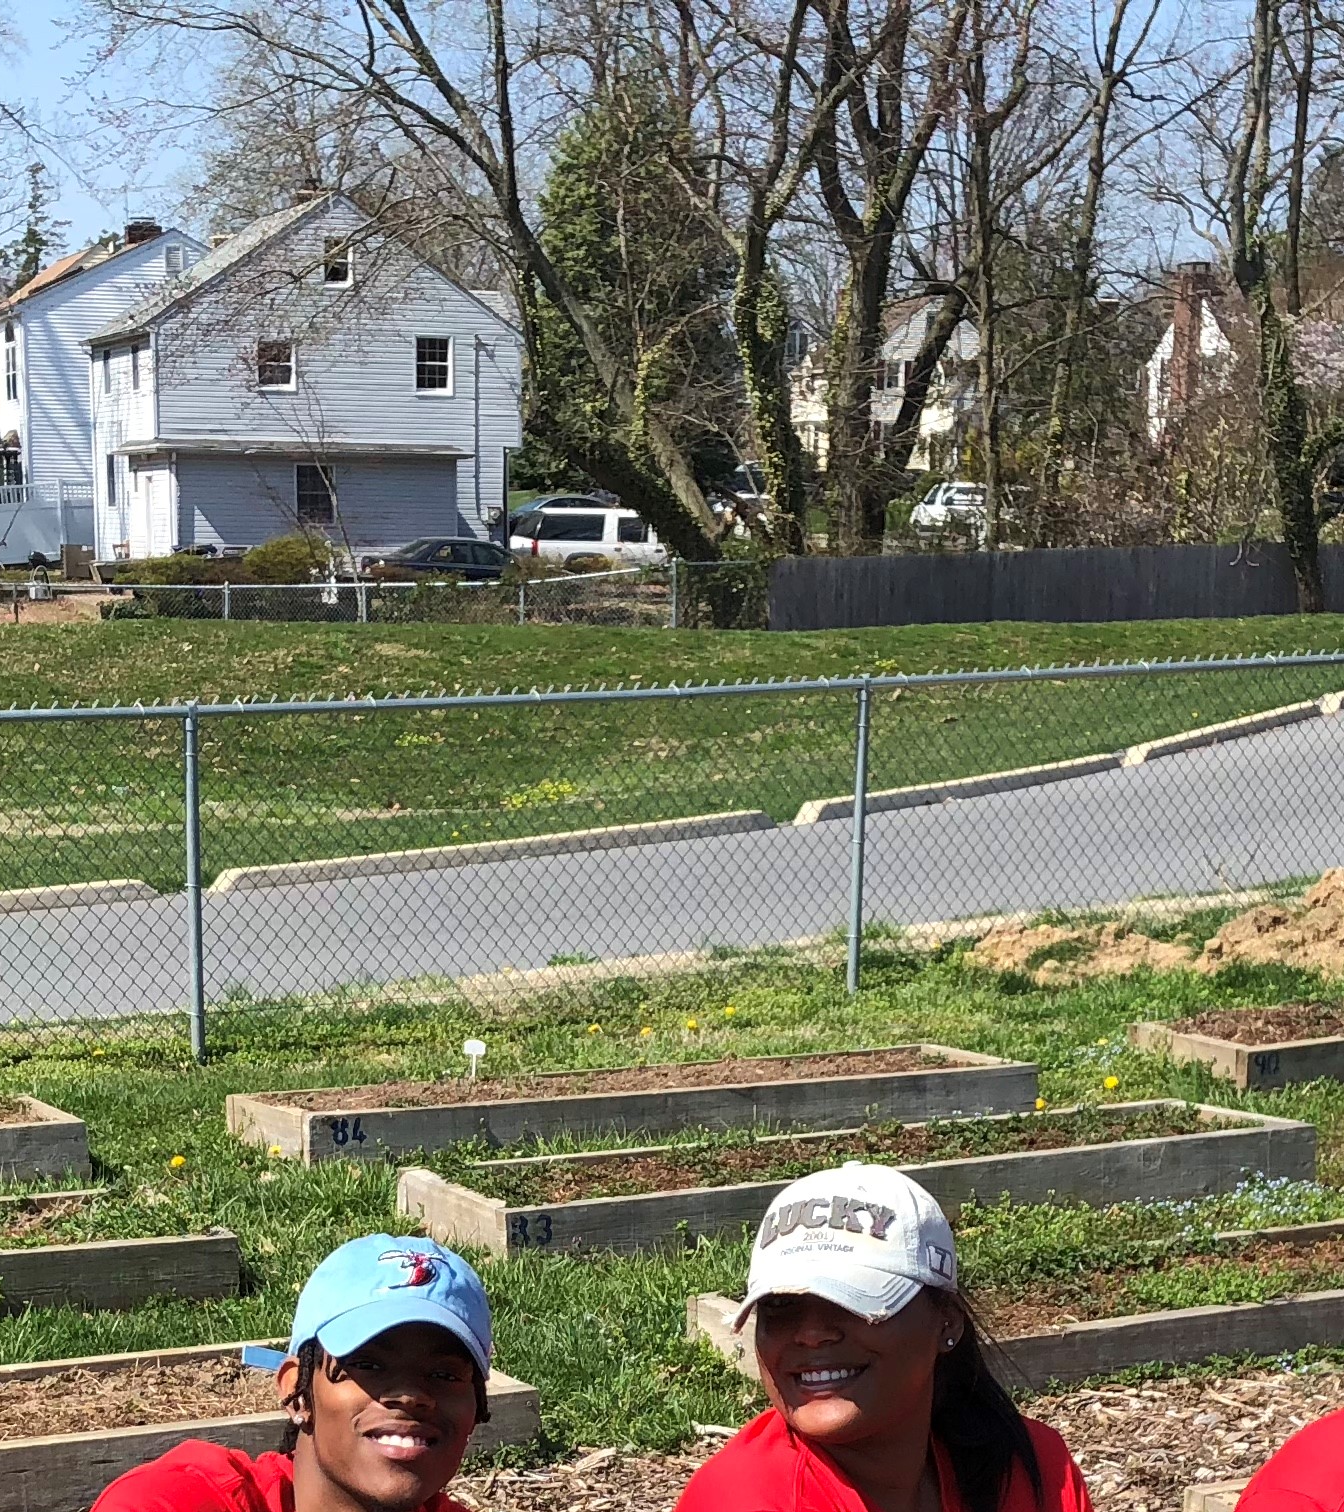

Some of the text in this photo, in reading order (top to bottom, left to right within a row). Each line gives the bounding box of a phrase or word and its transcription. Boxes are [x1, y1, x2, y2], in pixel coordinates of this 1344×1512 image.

[330, 1117, 368, 1147] 84
[511, 1214, 553, 1247] 83
[759, 1195, 897, 1250] LUCKY
[817, 1243, 855, 1253] VINTAGE
[933, 1246, 947, 1273] 7
